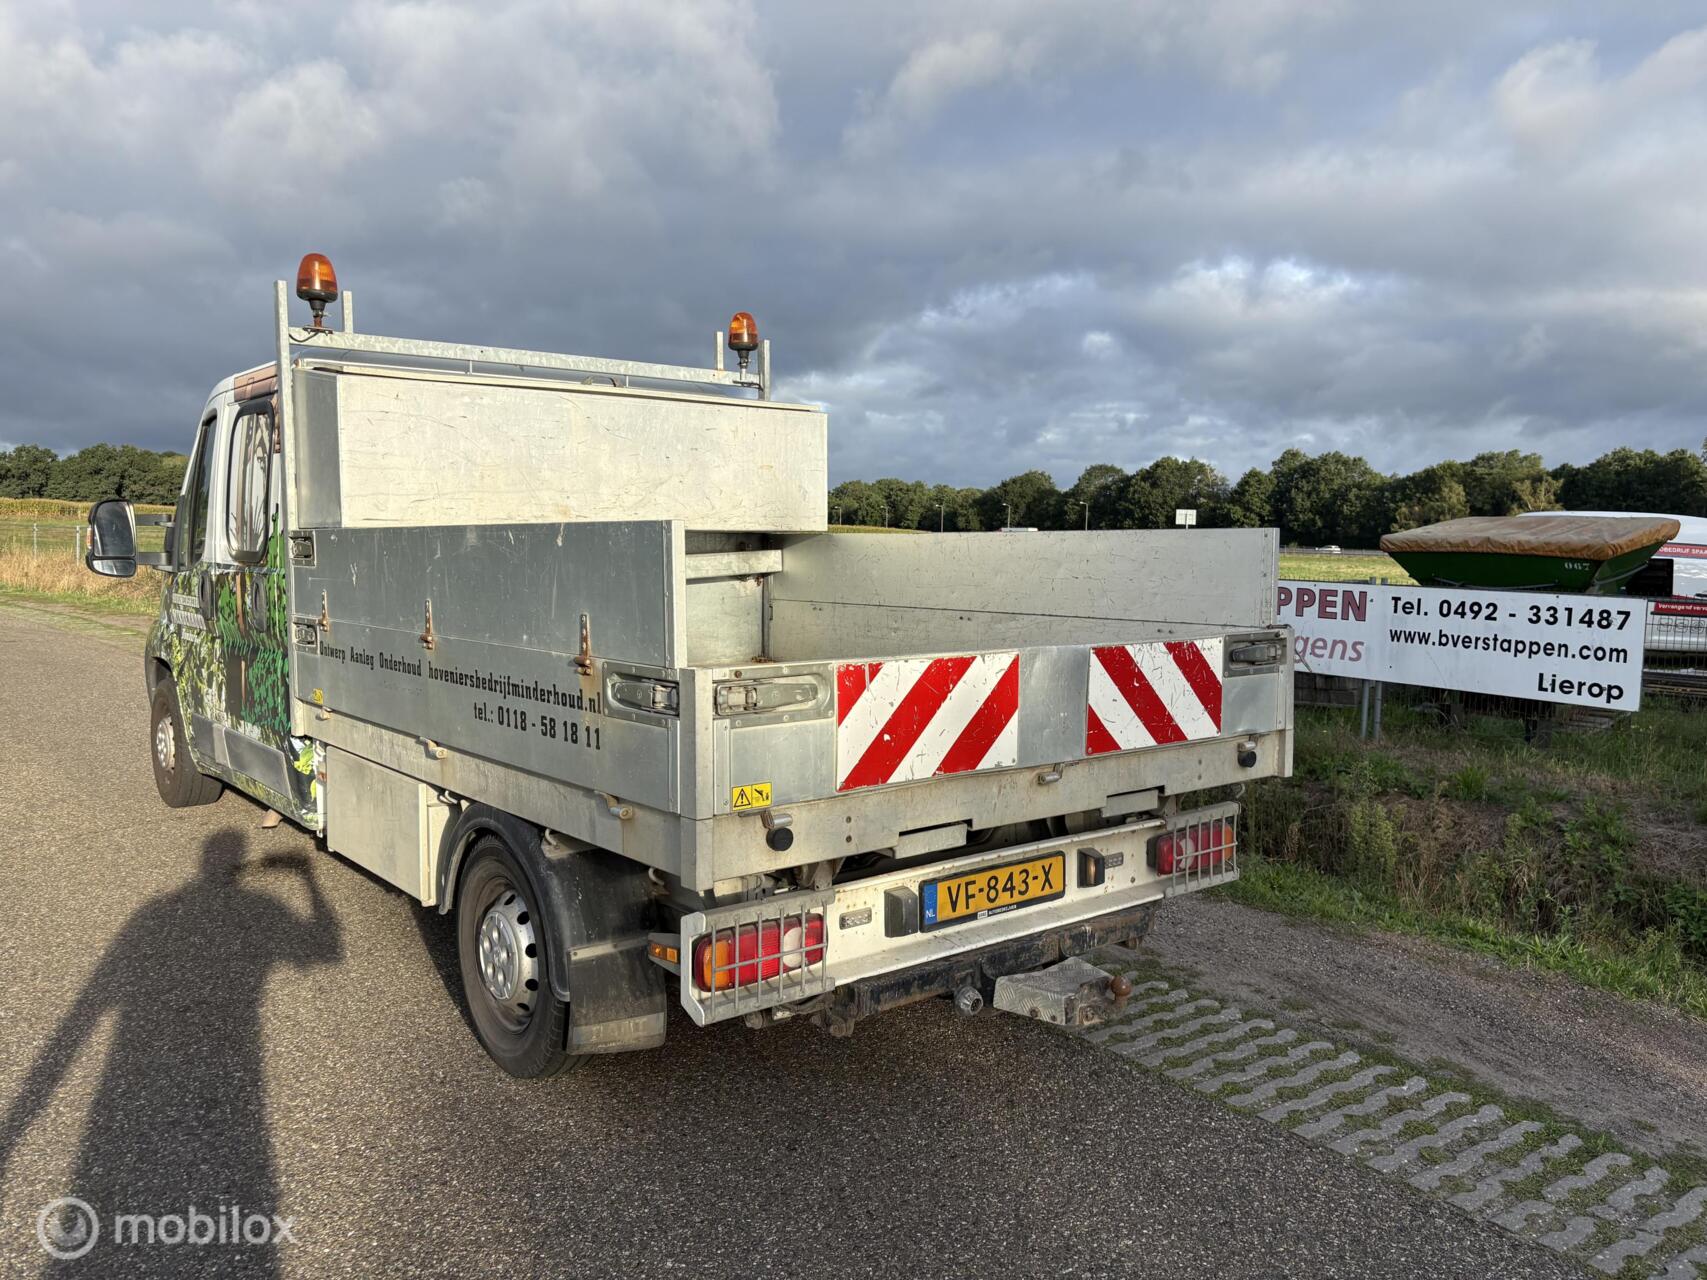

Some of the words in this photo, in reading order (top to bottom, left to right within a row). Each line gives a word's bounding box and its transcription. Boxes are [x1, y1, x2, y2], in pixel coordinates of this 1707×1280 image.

[1276, 586, 1367, 622] PPEN
[1391, 596, 1428, 617] Tel.
[1438, 599, 1499, 621] 0492
[1527, 605, 1631, 630] 331487
[1389, 628, 1628, 664] www.bverstappen.com
[319, 640, 346, 664] Ontwerp
[350, 646, 375, 671] Aanleg
[379, 651, 422, 677] Onderhoud
[428, 660, 601, 715] hoveniersbedrijfminderhoud.nl
[1537, 672, 1624, 704] Lierop
[473, 702, 494, 724] tel.:
[497, 705, 527, 732] 0118
[540, 715, 556, 740] 58
[563, 720, 578, 744] 18
[585, 725, 601, 750] 11
[946, 862, 1054, 913] VF-843-X
[925, 908, 936, 919] NL
